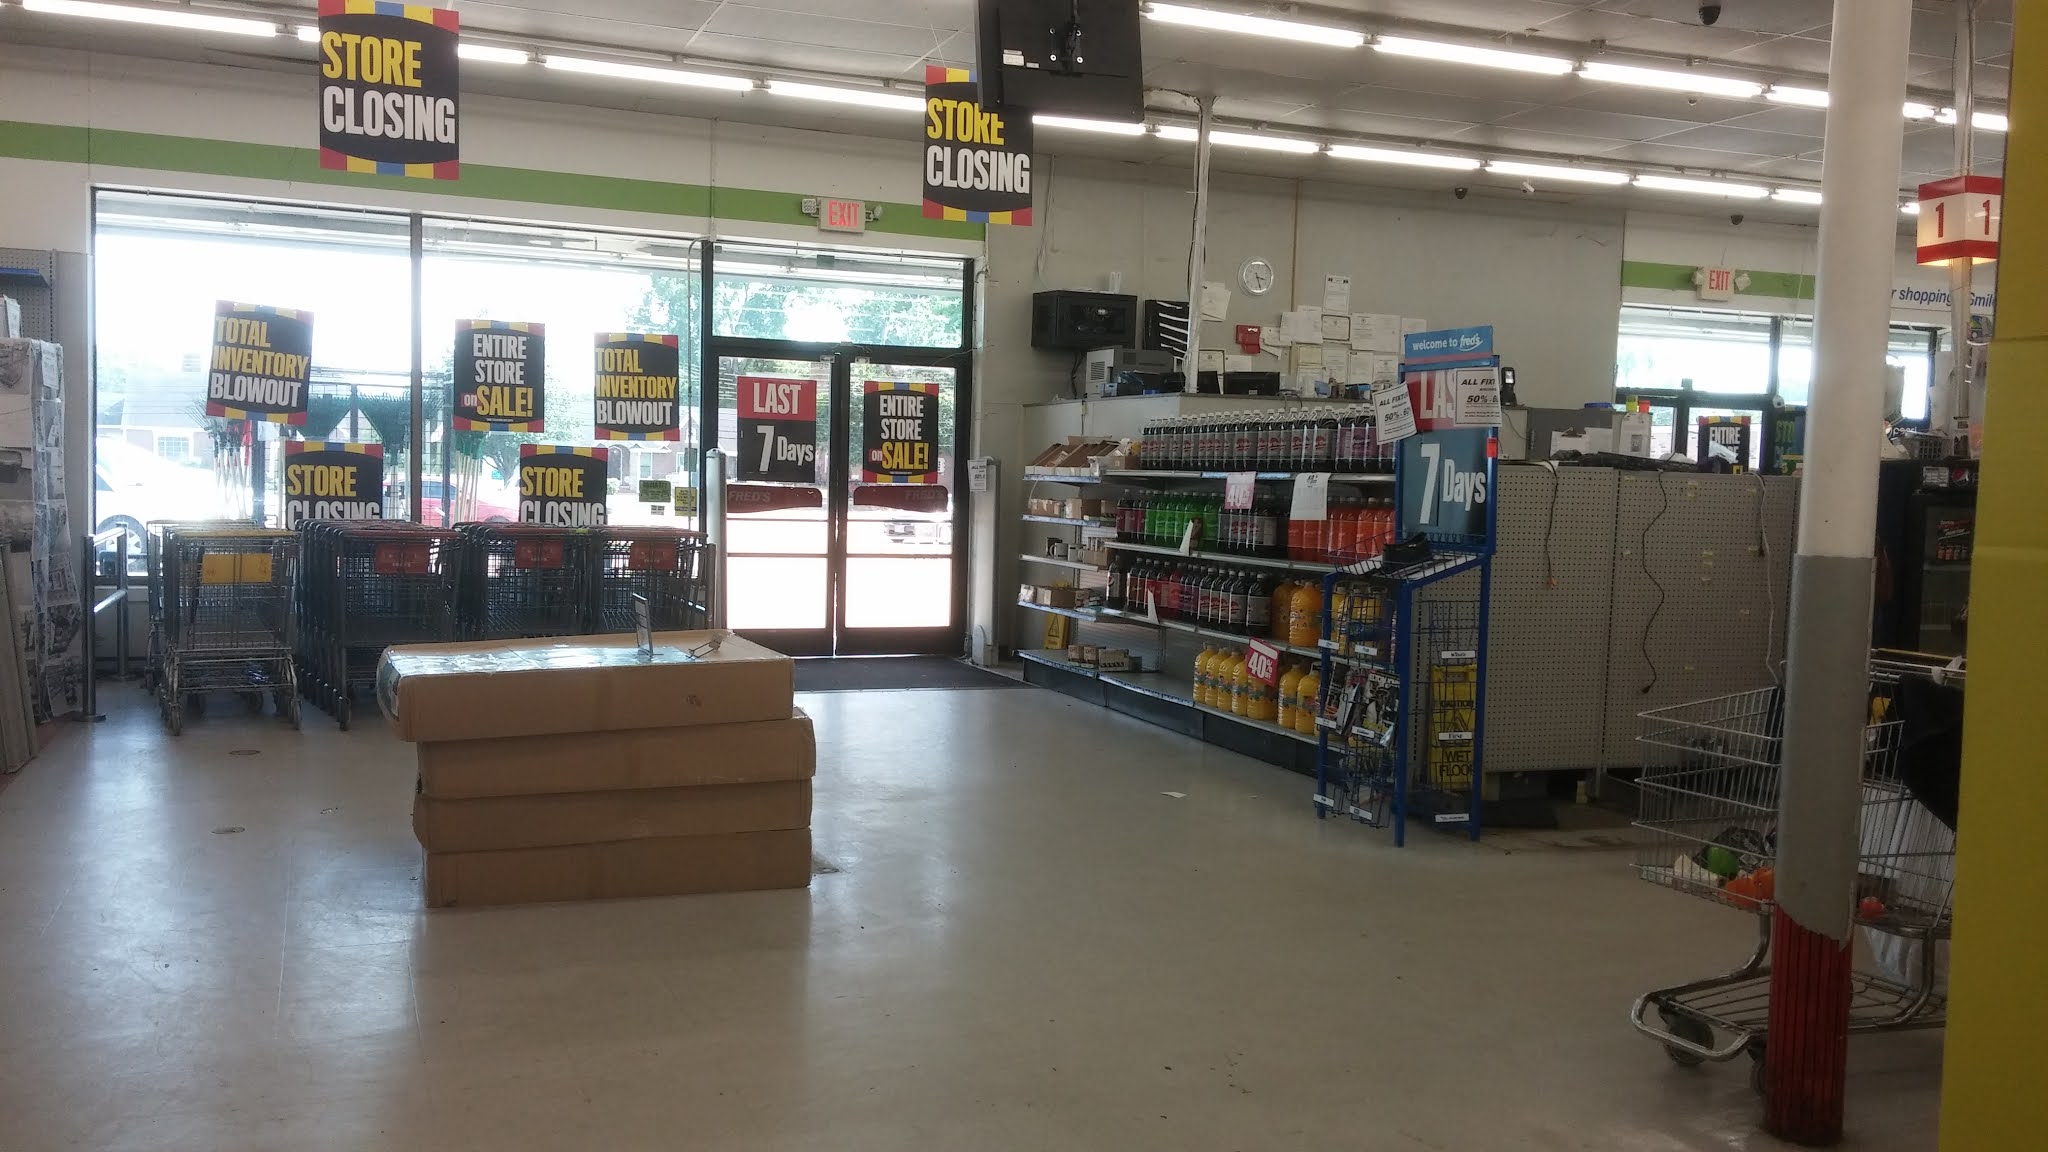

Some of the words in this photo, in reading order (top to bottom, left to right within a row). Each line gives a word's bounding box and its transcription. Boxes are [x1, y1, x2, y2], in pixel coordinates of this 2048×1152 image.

[322, 31, 422, 88] STORE
[323, 85, 456, 144] CLOSING
[927, 97, 1005, 145] STORE
[926, 145, 1030, 194] CLOSING
[829, 200, 859, 227] EXIT
[1936, 202, 1944, 238] 1
[1983, 199, 1990, 235] 1
[1708, 269, 1731, 291] EXIT
[1899, 287, 1952, 307] shopping
[1970, 292, 1995, 307] Smil
[215, 316, 271, 348] TOTAL
[473, 333, 527, 359] ENTIRE
[1412, 339, 1448, 351] welcome
[1449, 338, 1458, 347] to
[1459, 333, 1483, 350] fred's
[212, 346, 310, 380] INVENTORY
[475, 359, 524, 385] STORE
[595, 347, 643, 373] TOTAL
[210, 372, 302, 408] BLOWOUT
[595, 374, 677, 399] INVENTORY
[1420, 369, 1456, 419] LAS
[1461, 378, 1478, 386] ALL
[463, 393, 477, 407] on
[476, 385, 533, 418] SALE!
[596, 399, 673, 425] BLOWOUT
[753, 382, 802, 415] LAST
[879, 394, 924, 418] ENTIRE
[1379, 398, 1391, 407] ALL
[1466, 395, 1488, 403] 50%
[880, 418, 922, 440] STORE
[1709, 426, 1740, 445] ENTIRE
[757, 424, 775, 472] 7
[776, 435, 814, 466] Days
[871, 450, 883, 461] on
[882, 441, 929, 470] SALE!
[287, 464, 357, 497] STORE
[521, 466, 584, 498] STORE
[1420, 443, 1440, 524] 7
[1442, 458, 1486, 511] Days
[287, 499, 380, 530] CLOSING
[521, 499, 604, 527] CLOSING
[1444, 750, 1471, 763] WET
